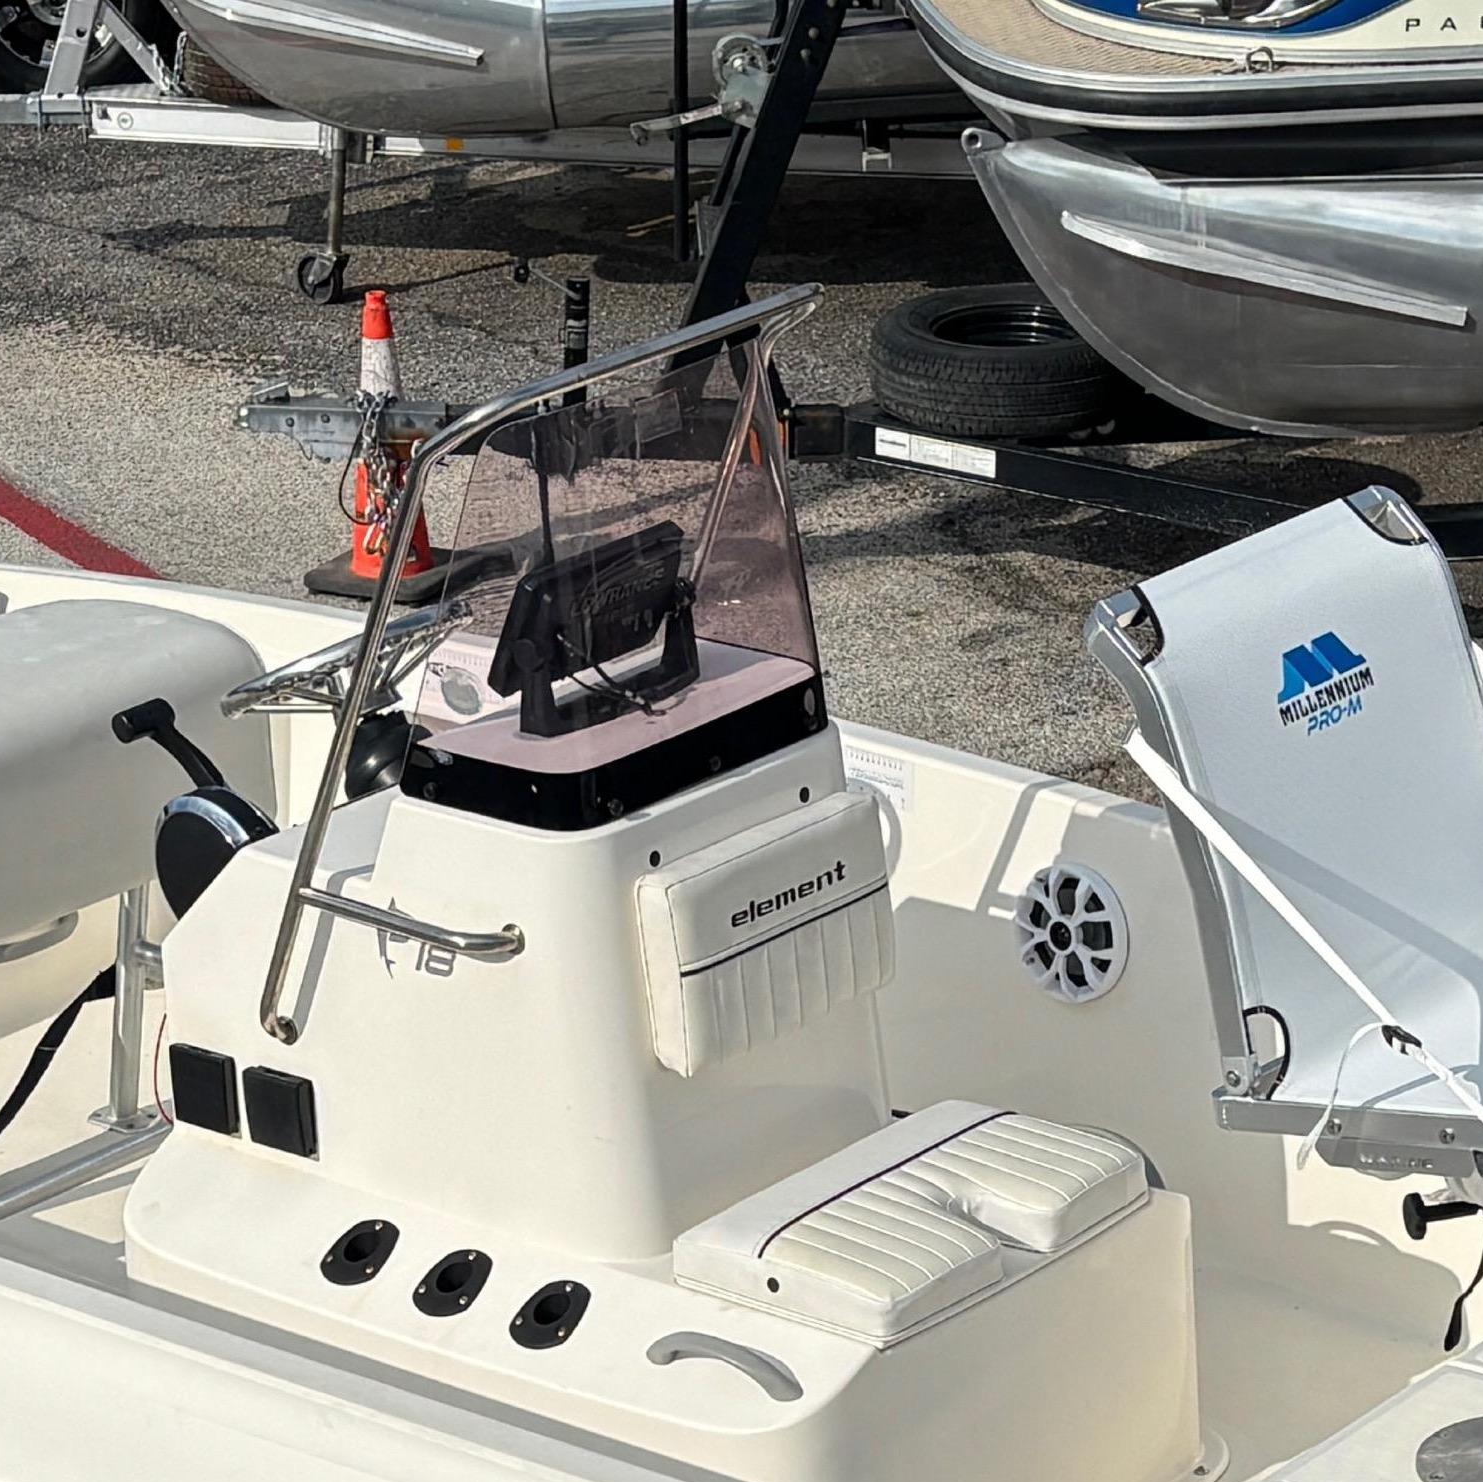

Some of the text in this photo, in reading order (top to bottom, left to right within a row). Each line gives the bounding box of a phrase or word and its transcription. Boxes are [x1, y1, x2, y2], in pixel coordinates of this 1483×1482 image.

[1279, 666, 1375, 727] MILLENNIUM
[1307, 694, 1363, 736] PRO-M
[731, 860, 846, 928] element
